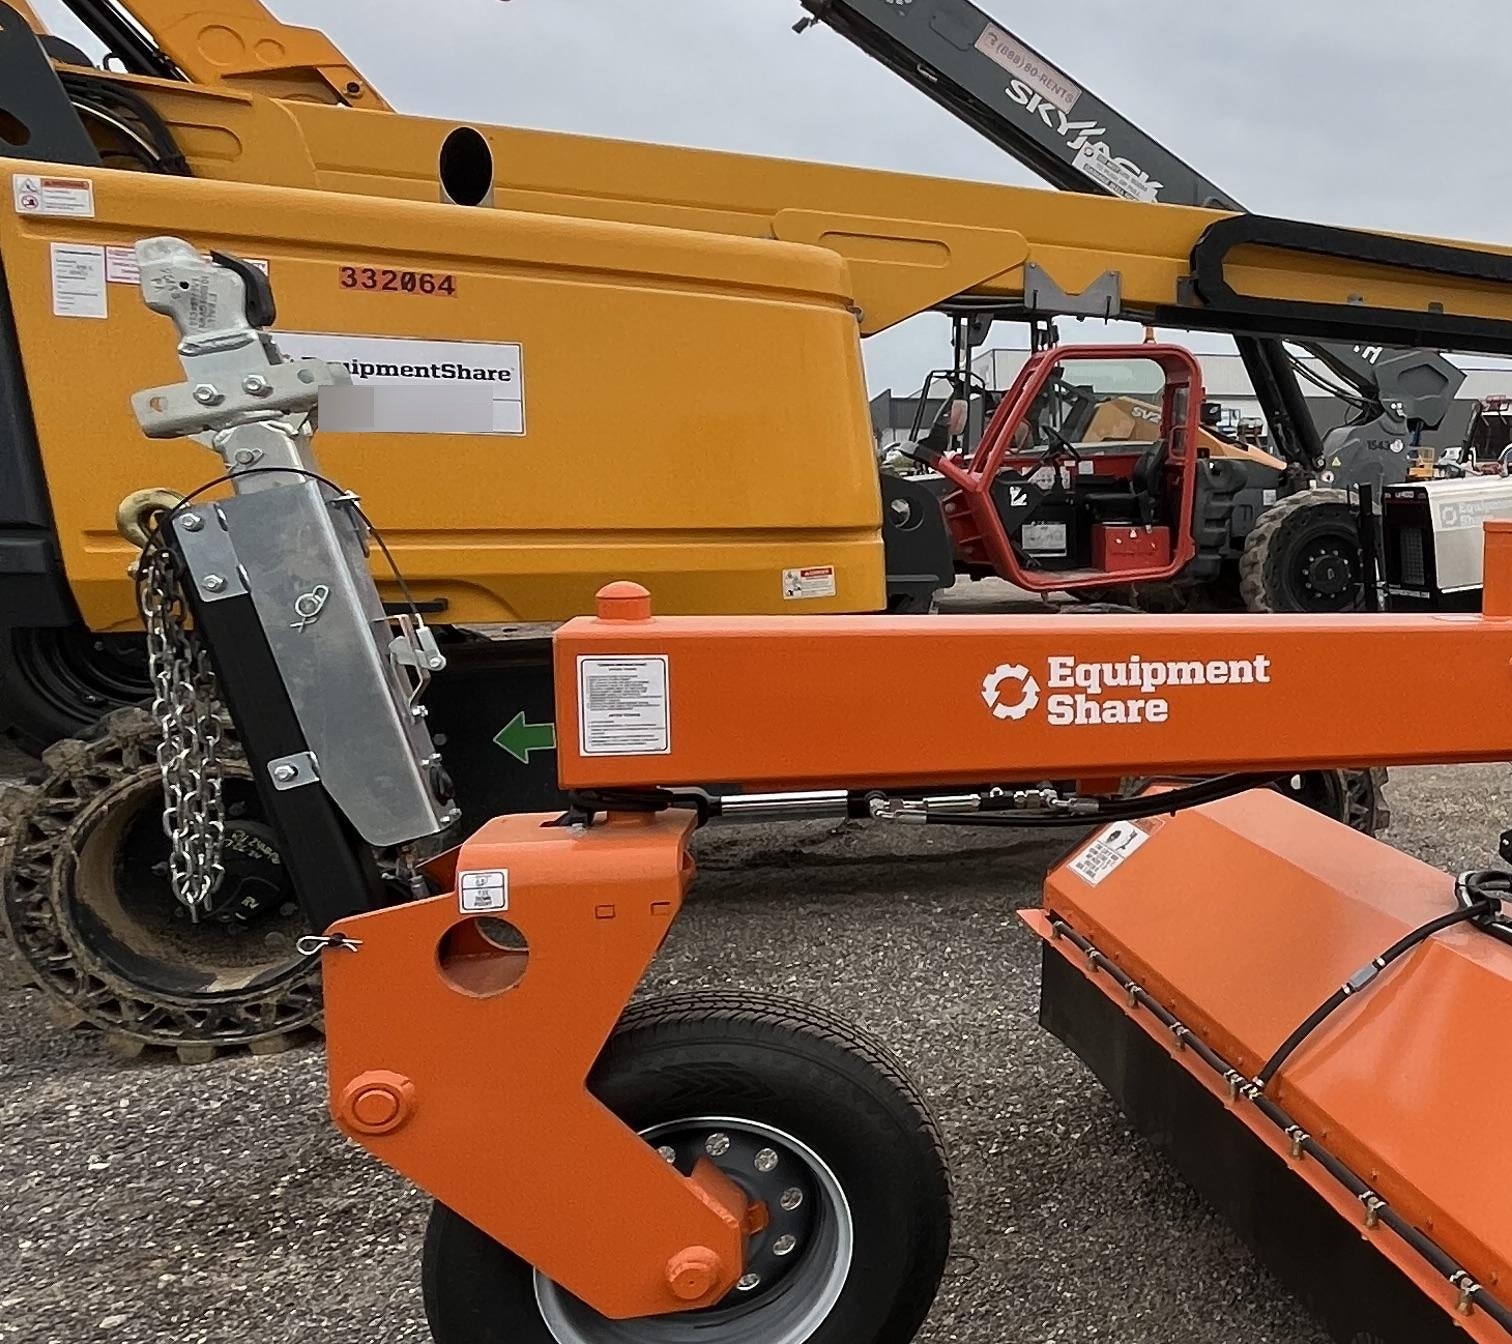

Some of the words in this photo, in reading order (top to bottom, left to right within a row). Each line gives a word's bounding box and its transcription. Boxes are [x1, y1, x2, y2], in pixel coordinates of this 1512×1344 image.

[340, 266, 457, 296] 332064
[301, 356, 512, 382] ipmentShare
[1047, 654, 1271, 695] Equipment
[1047, 693, 1169, 726] Share
